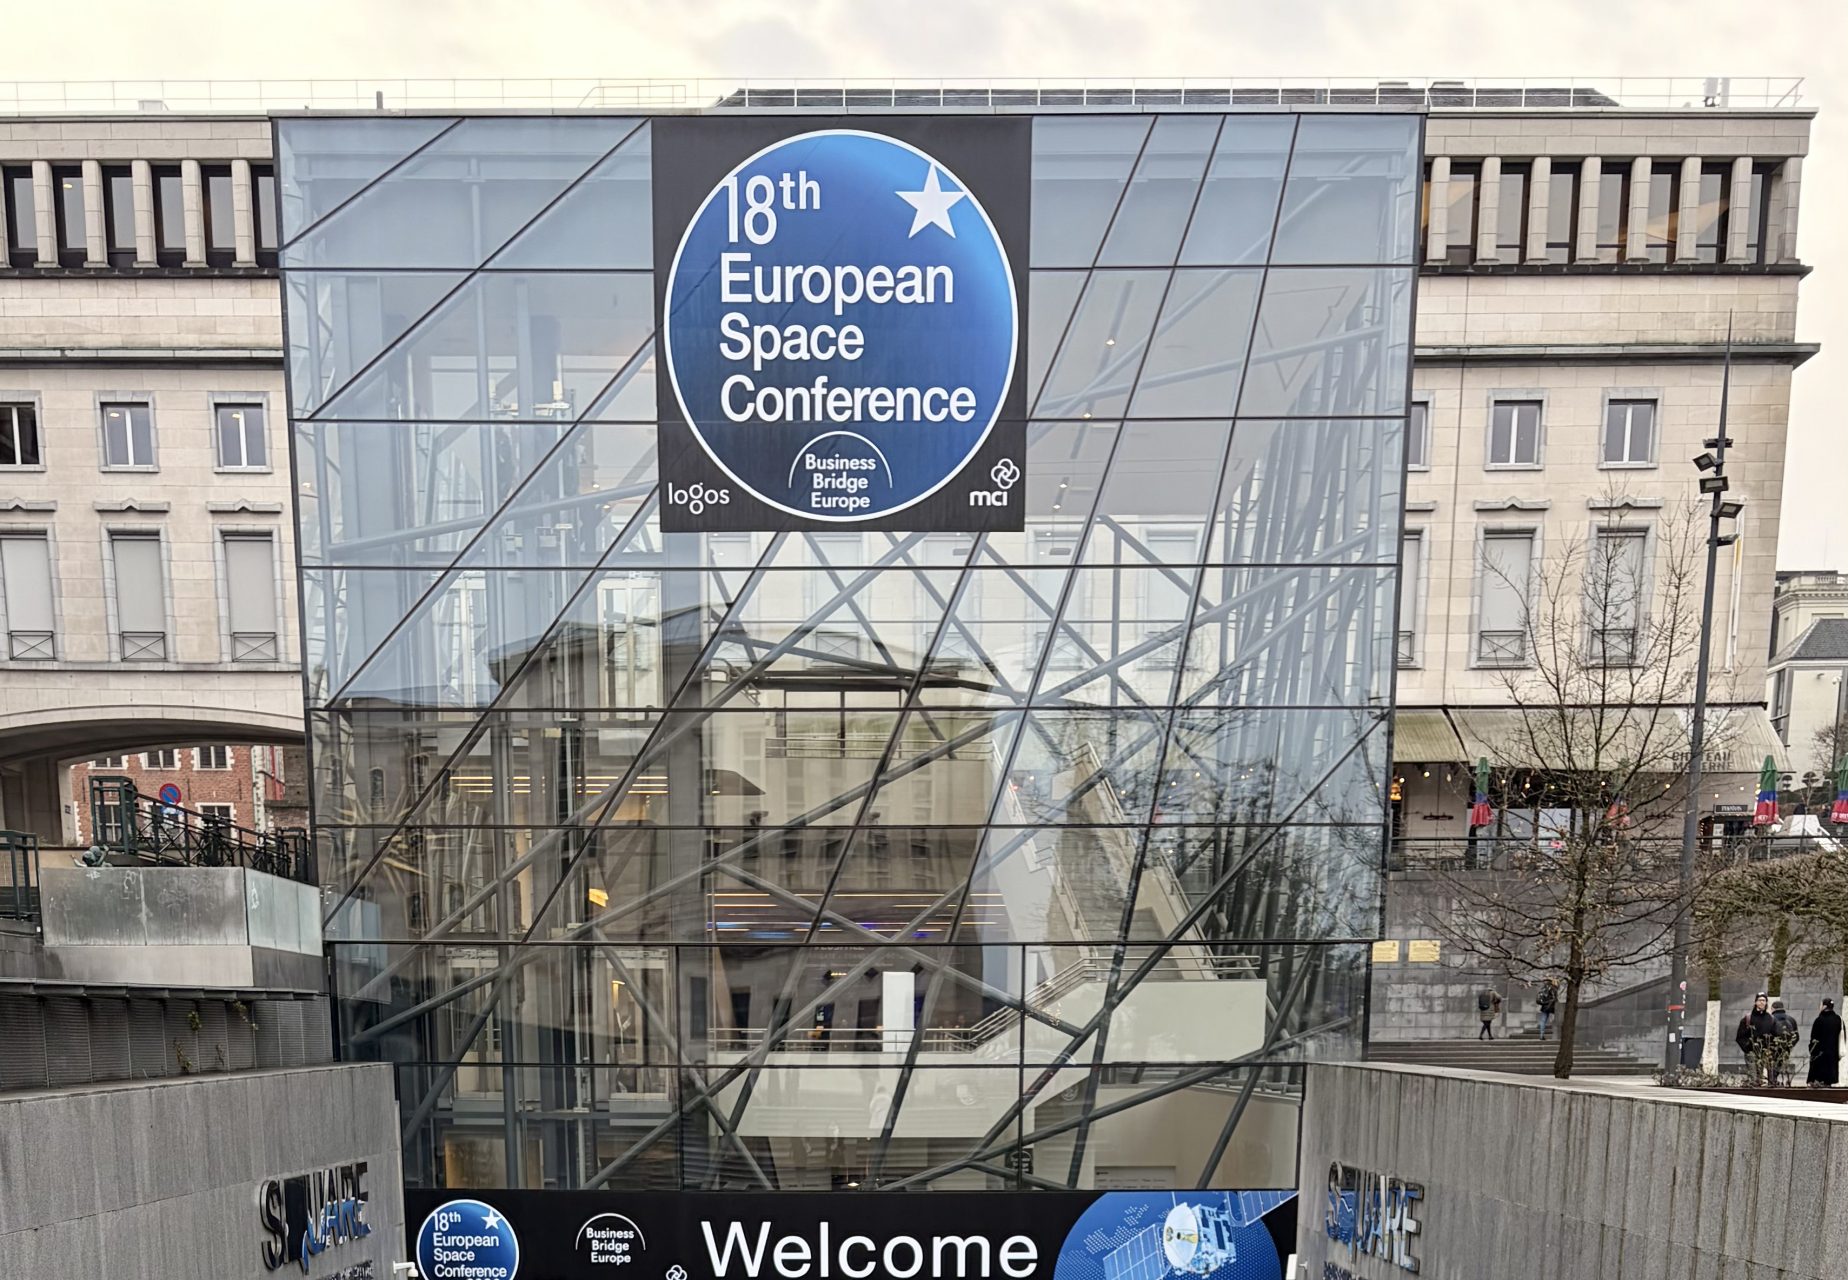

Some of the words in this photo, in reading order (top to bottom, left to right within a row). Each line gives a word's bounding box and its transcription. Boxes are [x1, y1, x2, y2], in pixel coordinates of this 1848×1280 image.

[722, 170, 821, 245] 18th
[720, 252, 954, 315] European
[719, 312, 865, 371] Space
[720, 374, 977, 423] Conference
[805, 454, 877, 471] Business
[812, 473, 869, 493] Bridge
[668, 482, 730, 515] logos
[810, 493, 871, 512] Europe
[969, 488, 1009, 507] mci
[433, 1211, 461, 1232] 18th
[433, 1232, 500, 1249] European
[586, 1227, 635, 1240] Business
[591, 1239, 630, 1253] Bridge
[701, 1221, 1039, 1279] Welcome
[433, 1248, 476, 1264] Space
[590, 1252, 632, 1266] Europe
[434, 1263, 508, 1279] Conference
